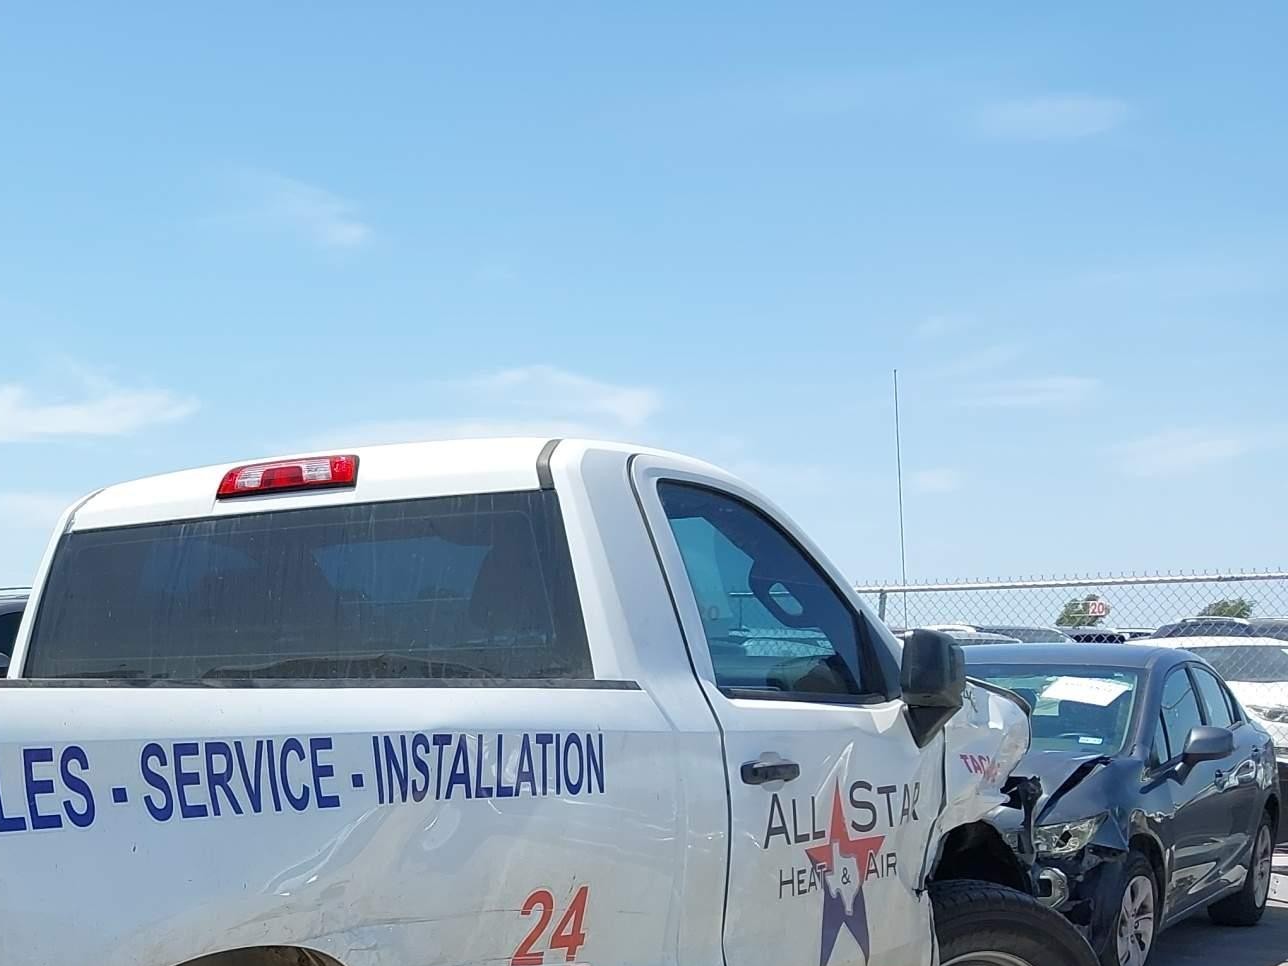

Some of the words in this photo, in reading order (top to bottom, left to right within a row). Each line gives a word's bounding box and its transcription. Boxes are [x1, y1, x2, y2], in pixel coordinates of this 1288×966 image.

[1090, 601, 1105, 615] 20
[140, 737, 341, 822] SERVICE
[372, 732, 605, 805] INSTALLATION
[763, 793, 826, 850] ALL
[849, 780, 920, 833] STAR
[779, 862, 827, 899] HEAT
[841, 871, 852, 885] &
[865, 851, 898, 881] AIR
